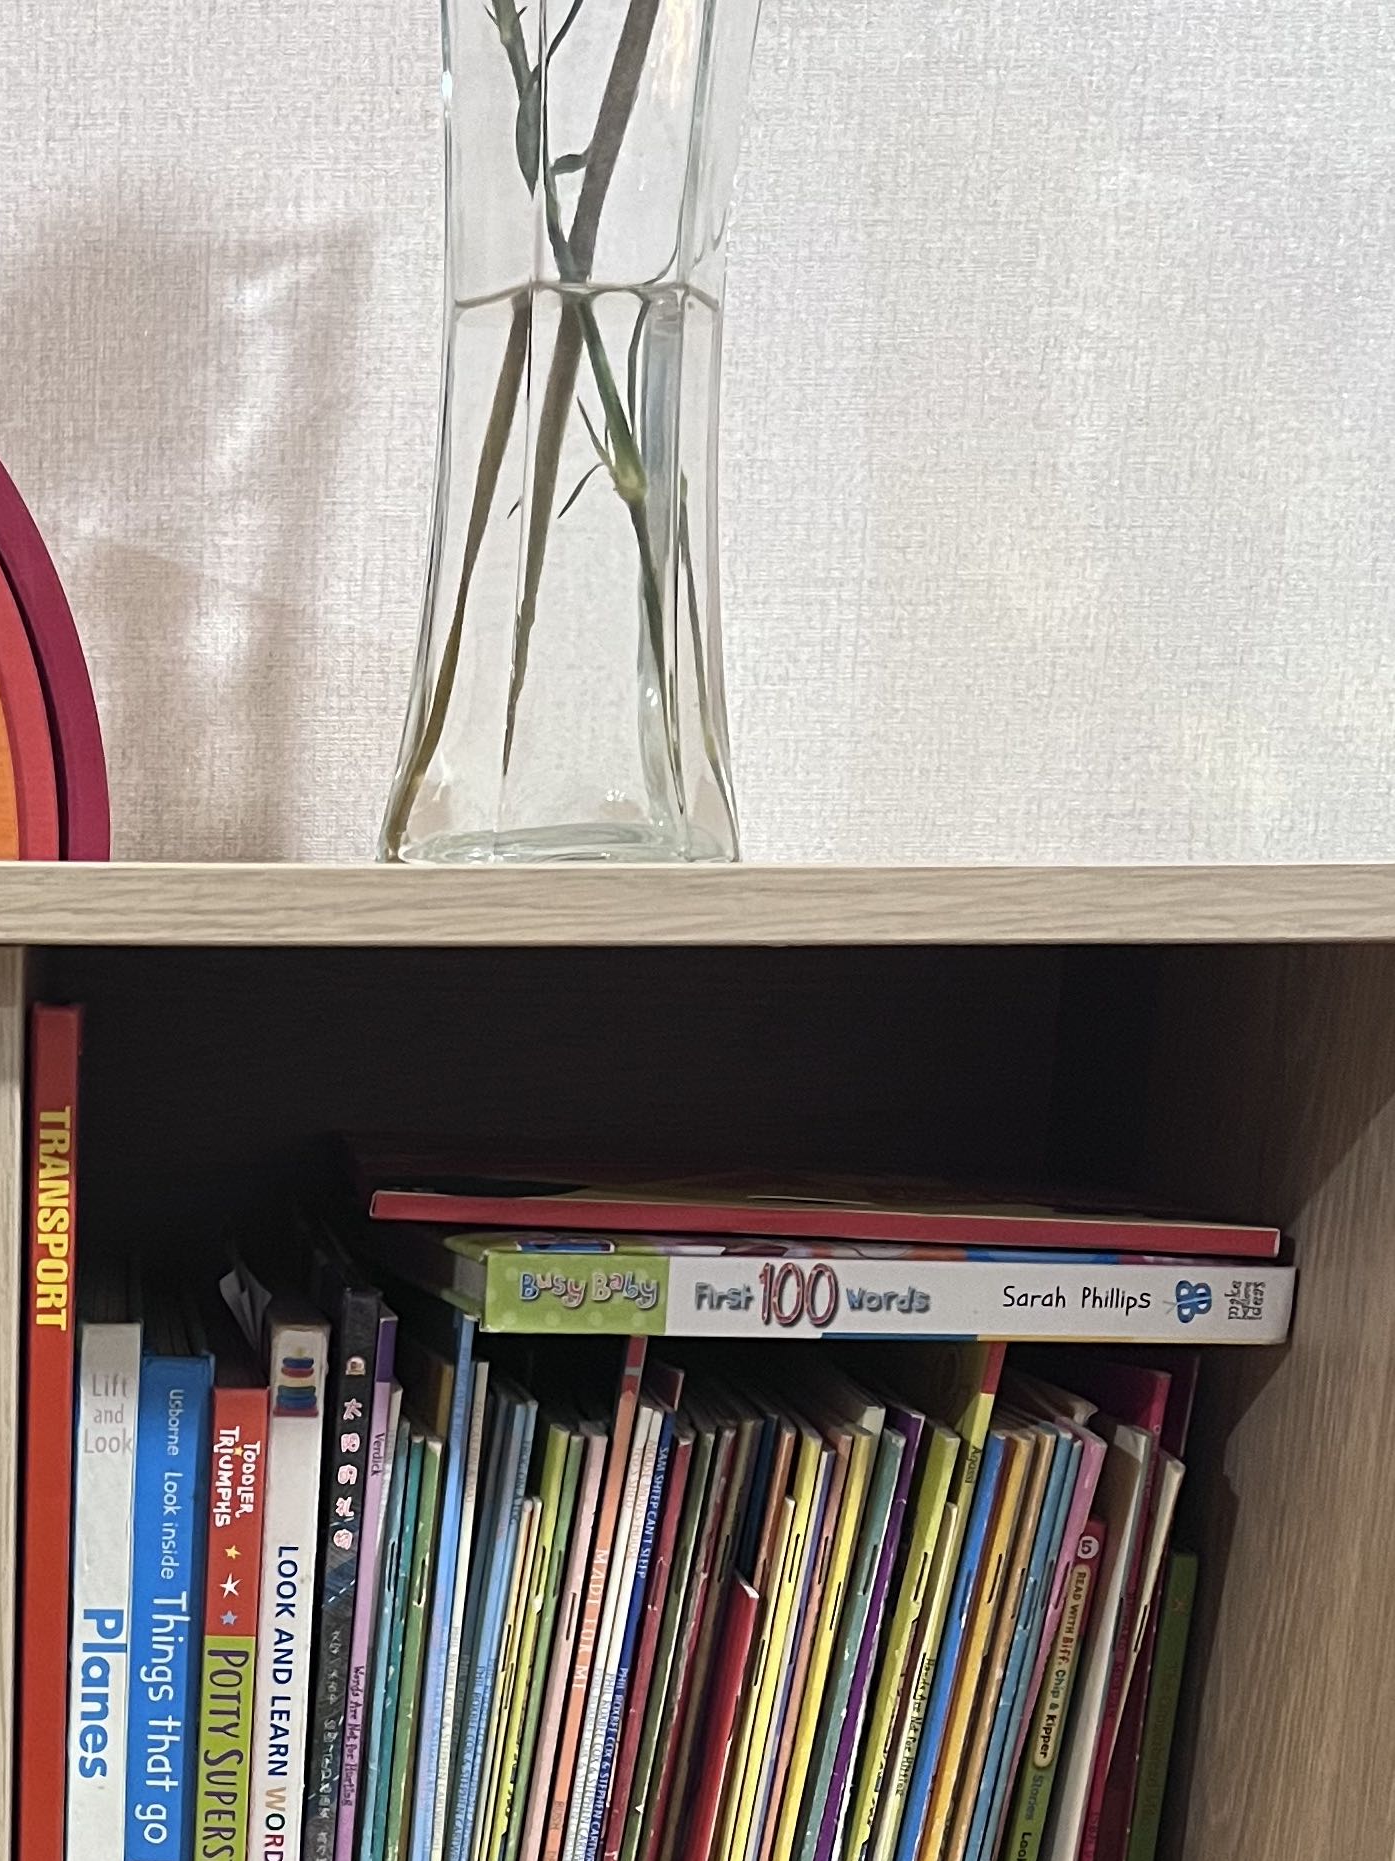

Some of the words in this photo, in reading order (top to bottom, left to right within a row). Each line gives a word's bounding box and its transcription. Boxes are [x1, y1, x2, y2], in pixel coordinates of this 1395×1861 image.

[35, 1106, 71, 1331] TRANSPORT
[519, 1272, 585, 1309] Busy
[591, 1272, 660, 1310] Baby
[694, 1282, 754, 1312] First
[758, 1262, 839, 1328] 100
[846, 1287, 932, 1314] Words
[1003, 1285, 1067, 1309] Sarah
[1080, 1286, 1152, 1316] Phillips
[91, 1373, 130, 1399] Lift
[92, 1405, 125, 1426] and
[83, 1431, 134, 1455] Look
[369, 1433, 384, 1476] Verdick
[654, 1447, 668, 1471] SAM
[213, 1425, 240, 1528] TRIUMPHS
[235, 1440, 261, 1519] TODDLER
[963, 1445, 981, 1483] Agassi
[162, 1472, 184, 1516] Look
[648, 1473, 664, 1508] SHEEP
[160, 1522, 180, 1580] inside
[635, 1546, 651, 1579] SLEEP
[1079, 1540, 1095, 1555] 5
[274, 1545, 299, 1619] LOOK
[585, 1548, 609, 1605] MADE
[1071, 1571, 1087, 1601] READ
[577, 1618, 597, 1654] FOR
[1064, 1604, 1080, 1633] WITH
[140, 1590, 190, 1714] Things
[271, 1634, 295, 1685] AND
[79, 1608, 125, 1779] Planes
[205, 1649, 249, 1740] POTTY
[351, 1665, 364, 1696] Words
[571, 1664, 589, 1689] ME
[601, 1673, 615, 1696] PHIL
[615, 1667, 628, 1690] PHIL
[1050, 1669, 1066, 1697] Chip
[349, 1701, 361, 1719] Are
[607, 1696, 623, 1734] ROXBEE
[908, 1715, 924, 1732] Not
[1047, 1702, 1059, 1711] &
[267, 1696, 291, 1776] LEARN
[347, 1723, 359, 1742] Not
[602, 1737, 617, 1760] COX
[146, 1716, 183, 1793] that
[599, 1760, 611, 1769] &
[341, 1763, 355, 1806] Hurting
[454, 1770, 470, 1815] STEPHEN
[590, 1772, 608, 1821] STEPHEN
[1024, 1775, 1043, 1820] Stories
[132, 1803, 168, 1845] go
